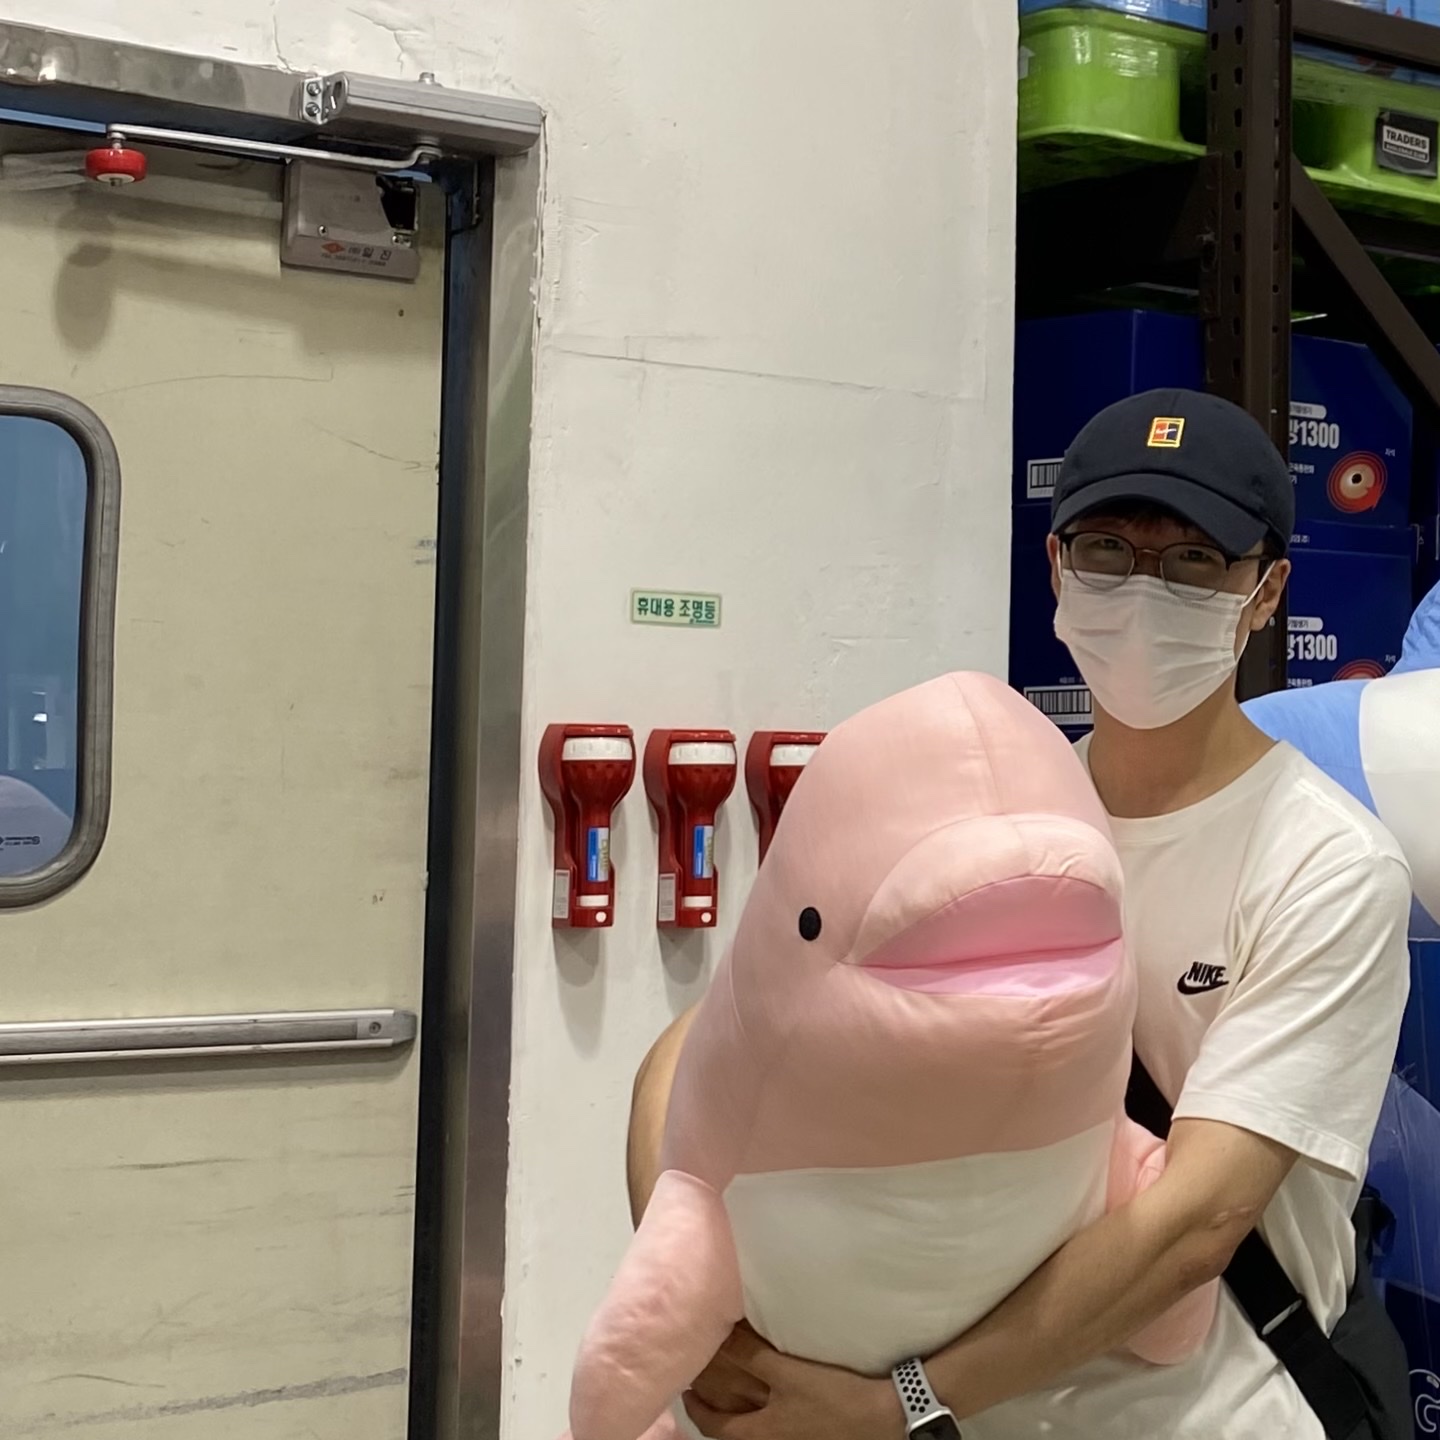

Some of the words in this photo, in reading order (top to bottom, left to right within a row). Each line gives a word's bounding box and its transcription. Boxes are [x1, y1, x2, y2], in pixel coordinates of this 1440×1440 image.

[1386, 129, 1427, 149] TRADERS
[637, 597, 675, 617] 휴대용
[679, 599, 716, 620] 조명등
[1187, 961, 1227, 985] NIKE
